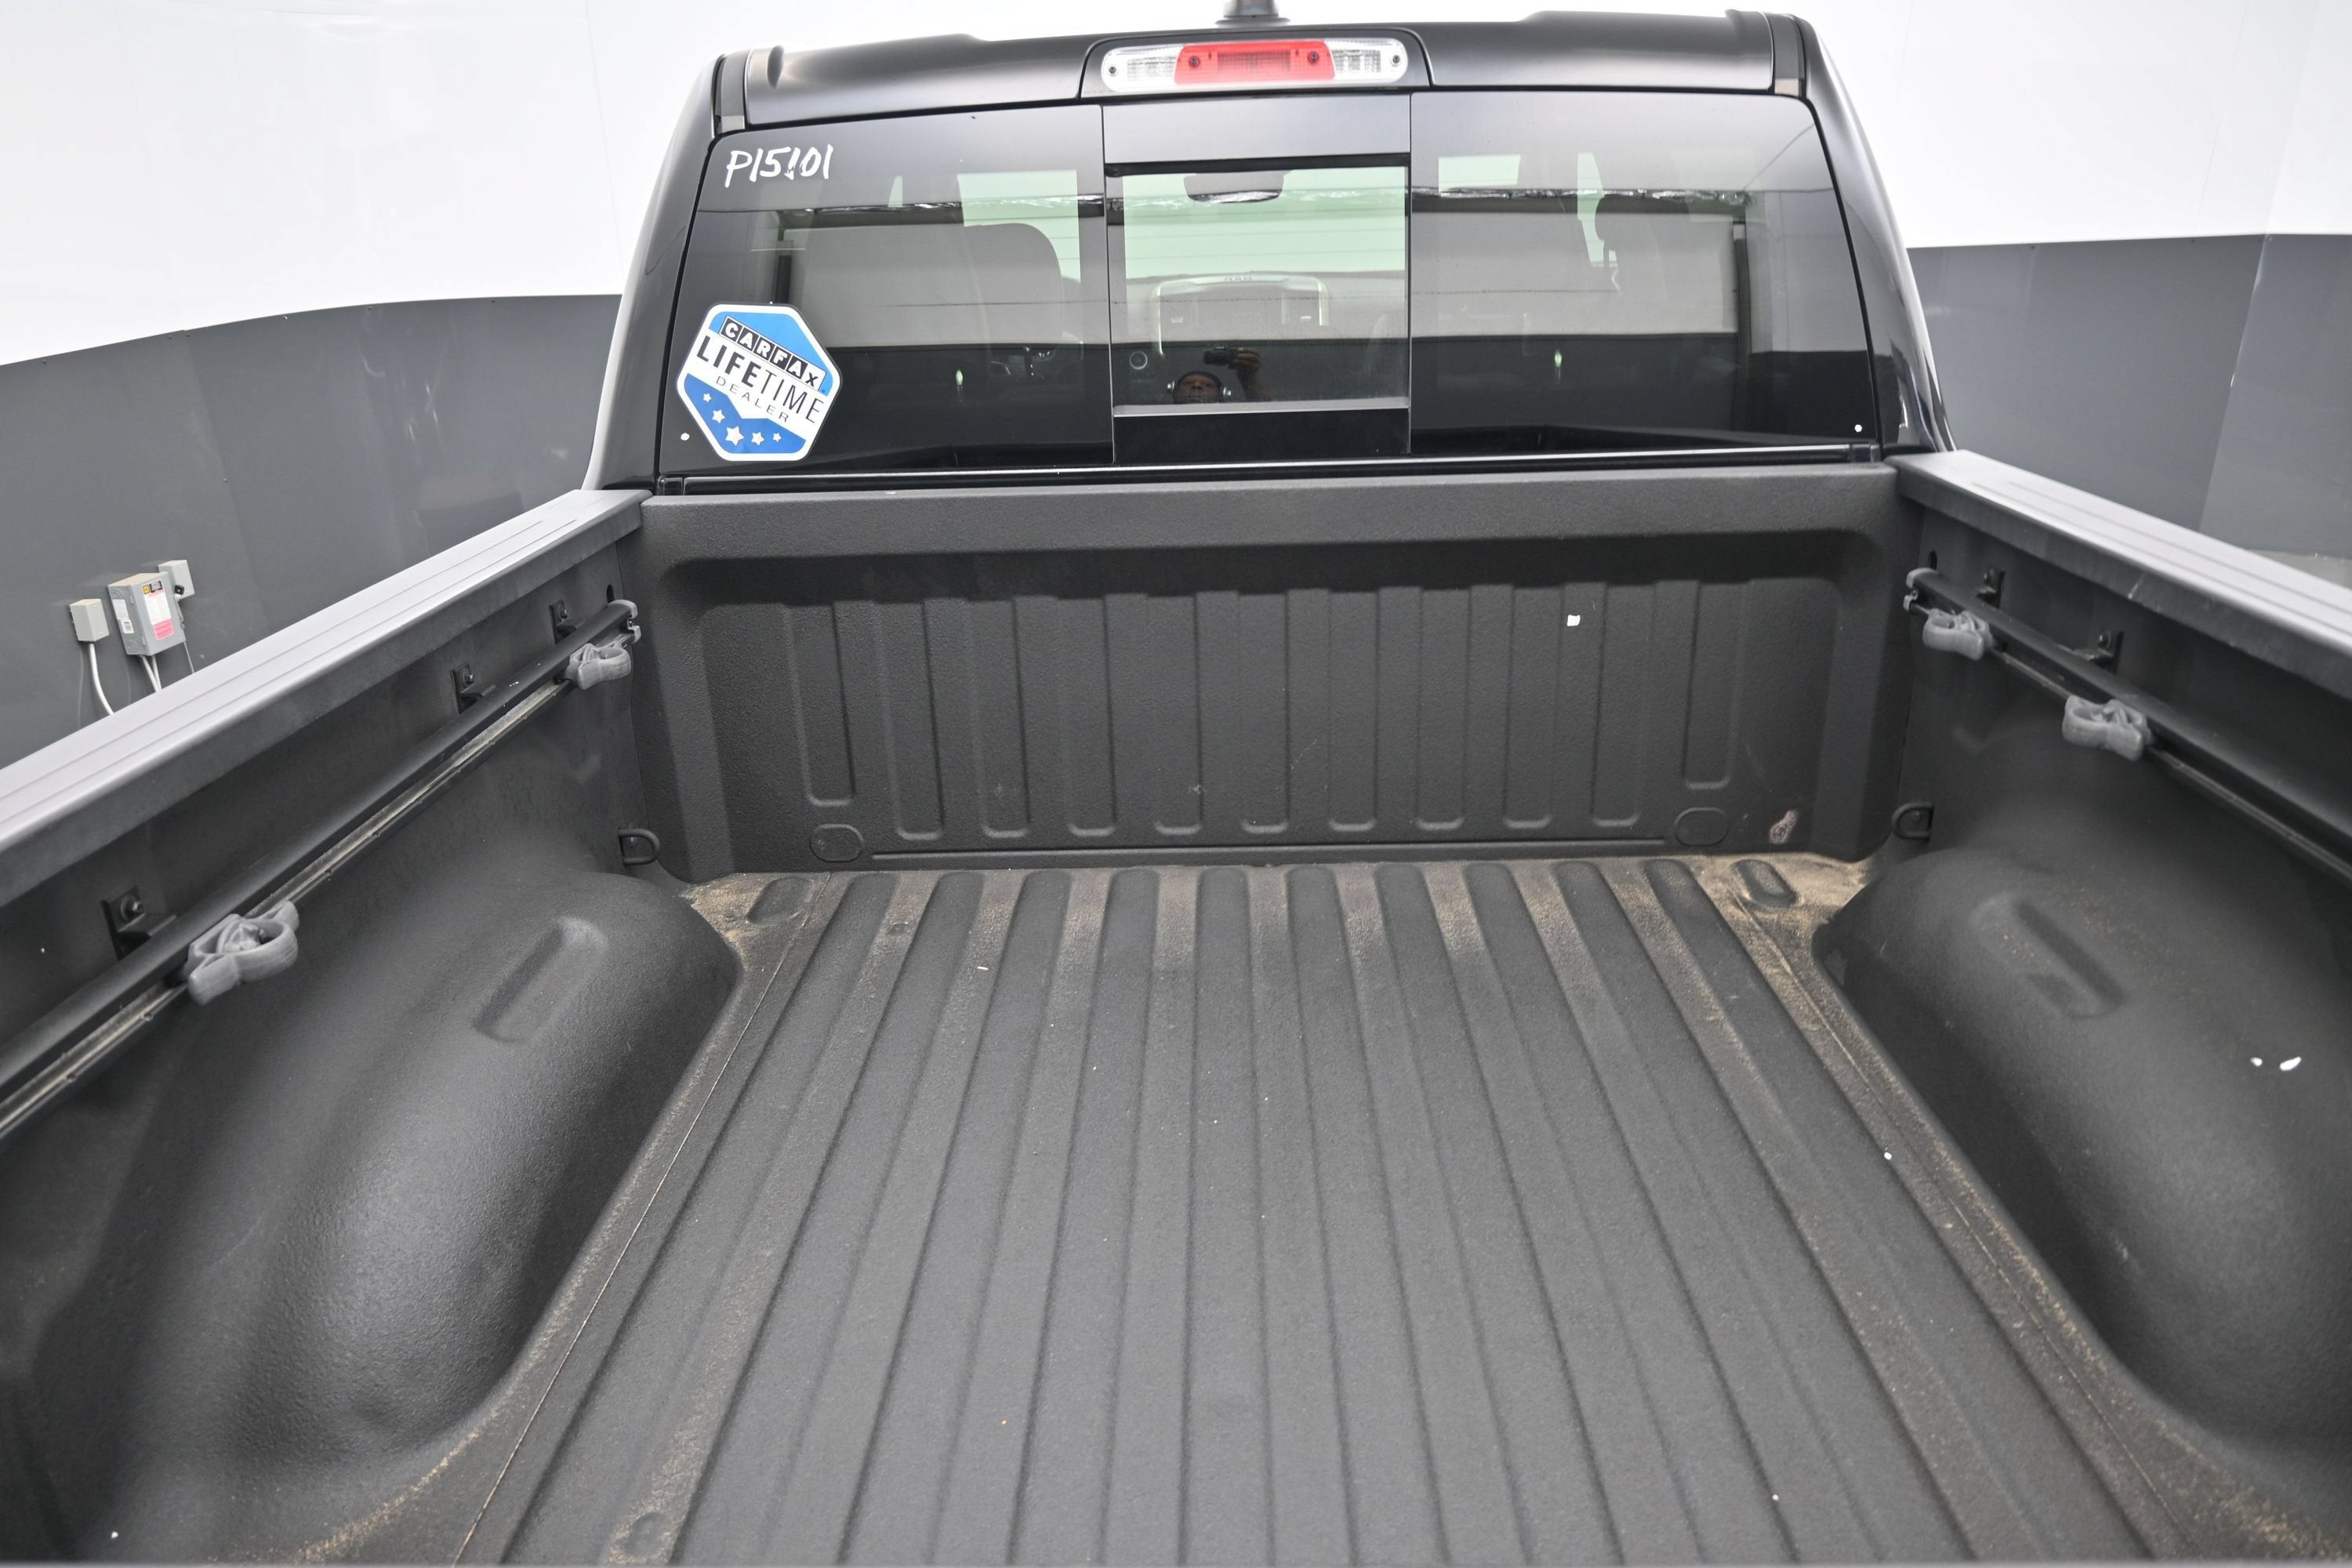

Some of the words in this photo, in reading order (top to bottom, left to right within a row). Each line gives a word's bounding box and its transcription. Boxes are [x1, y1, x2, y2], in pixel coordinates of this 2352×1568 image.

[696, 335, 825, 423] LIFETIME
[721, 318, 819, 388] CARFAX
[715, 376, 789, 423] DEALER
